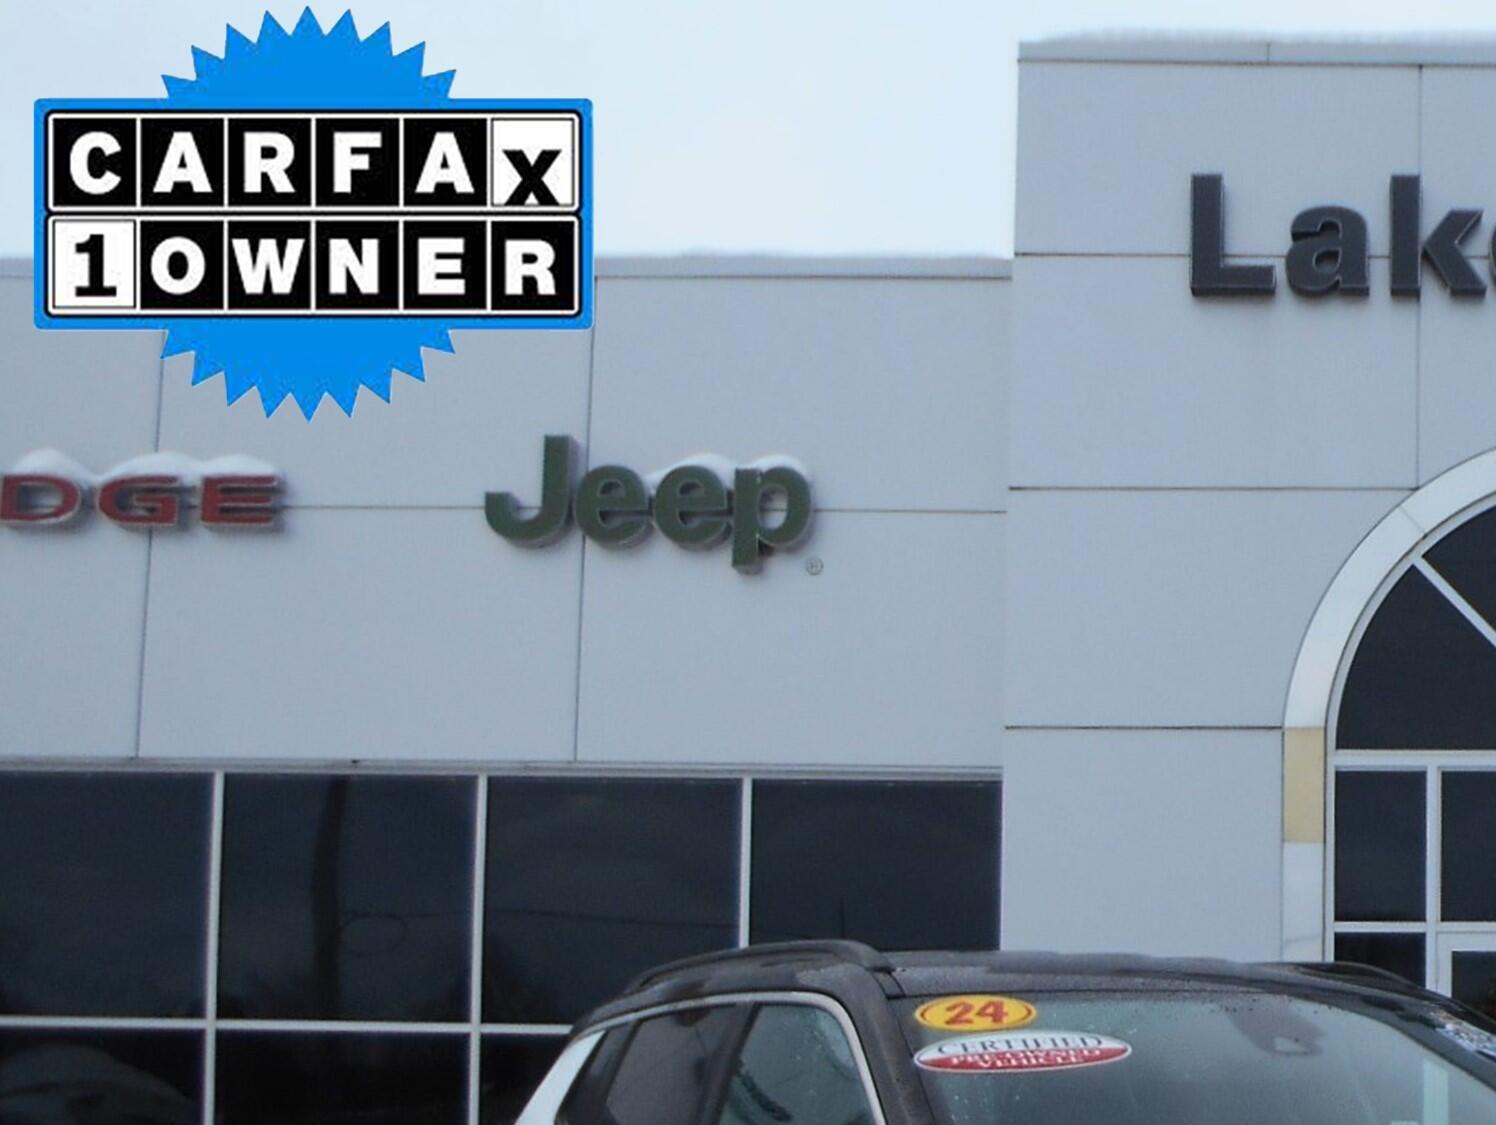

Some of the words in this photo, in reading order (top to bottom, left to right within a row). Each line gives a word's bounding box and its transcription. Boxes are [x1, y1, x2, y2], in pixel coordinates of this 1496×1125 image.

[484, 434, 813, 574] Jeep
[944, 1000, 1008, 1026] 24
[937, 1035, 1103, 1055] CERTIFIED
